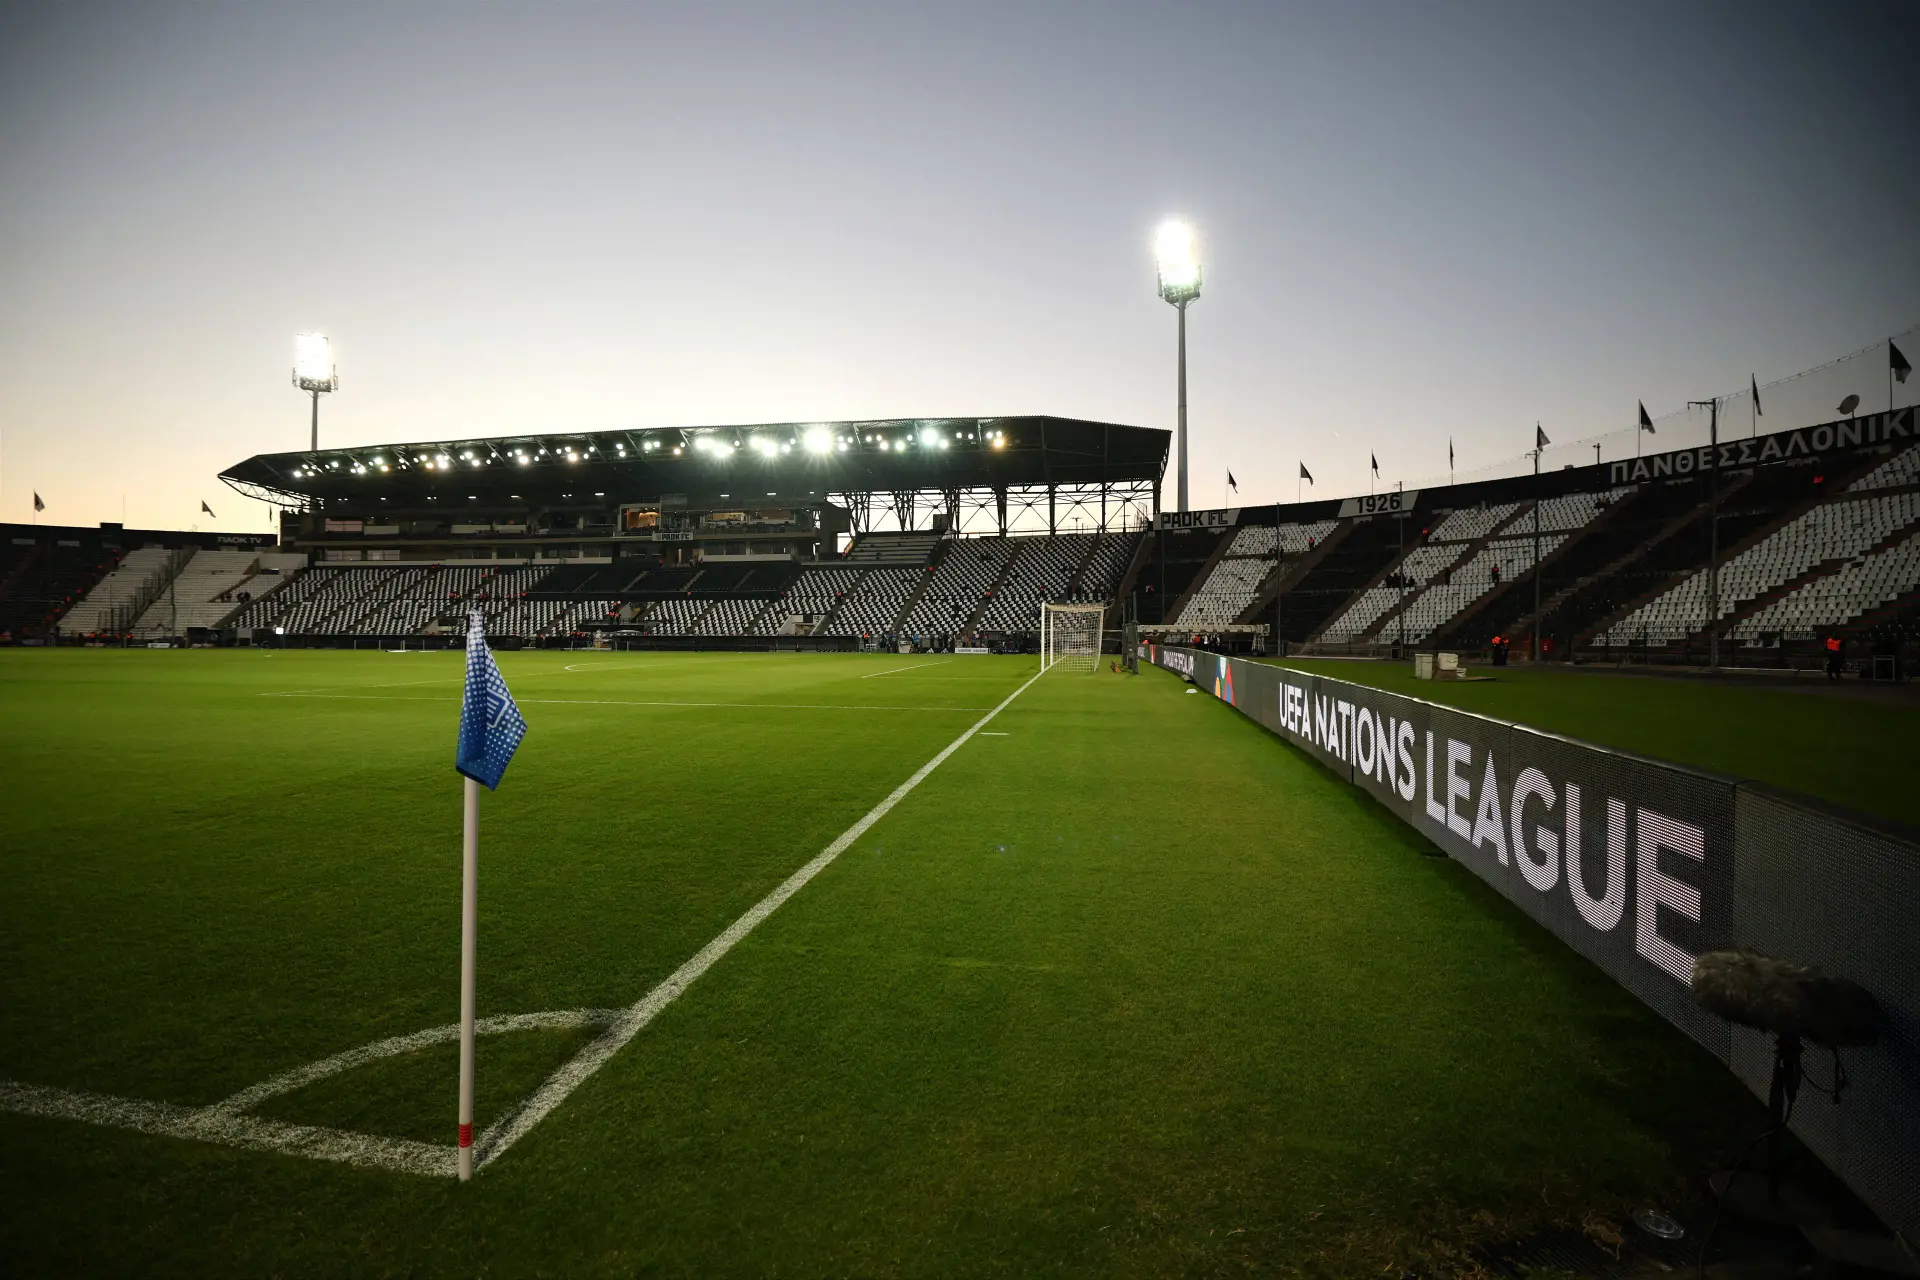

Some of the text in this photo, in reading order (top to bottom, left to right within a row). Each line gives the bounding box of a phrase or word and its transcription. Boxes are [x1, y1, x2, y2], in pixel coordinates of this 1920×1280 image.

[1357, 494, 1400, 514] 1926
[1161, 510, 1228, 529] PAOK FC
[1279, 682, 1705, 988] UEFA NATIONS LEAGUE
